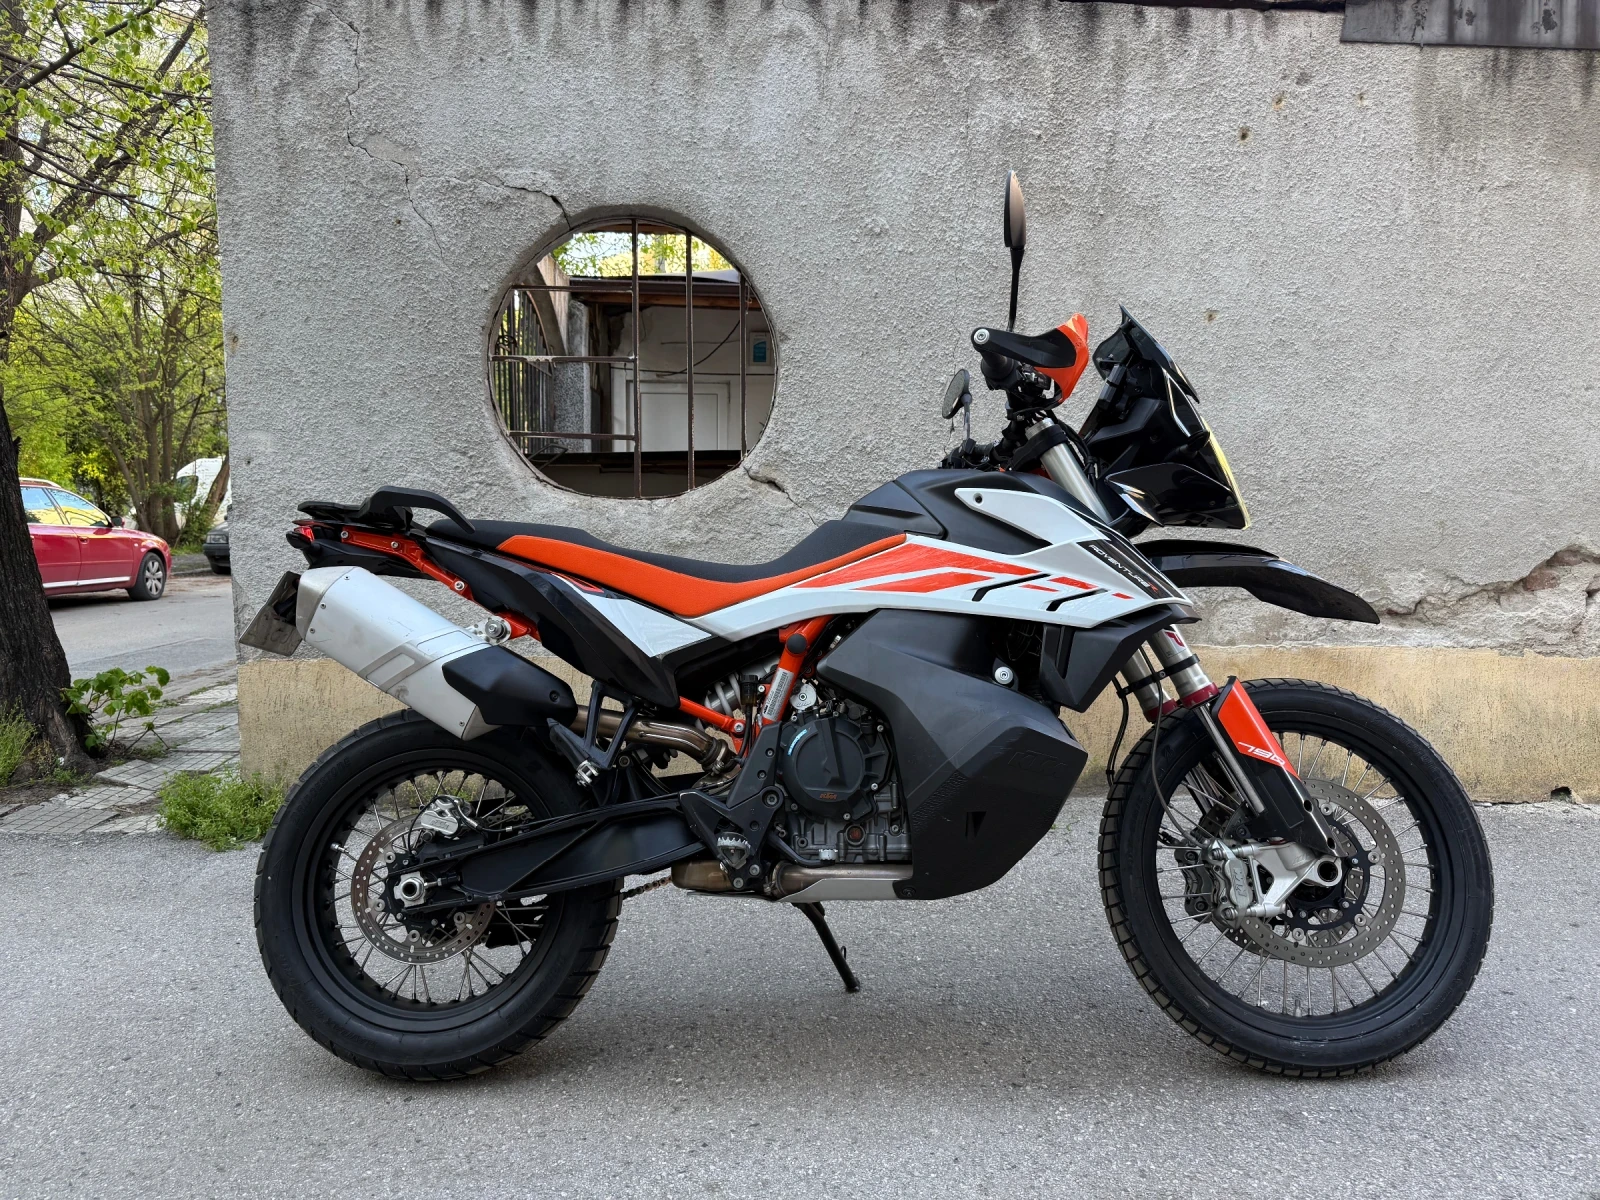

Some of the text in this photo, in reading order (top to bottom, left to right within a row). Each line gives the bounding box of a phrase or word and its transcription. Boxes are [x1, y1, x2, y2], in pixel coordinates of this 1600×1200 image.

[1088, 543, 1151, 588] ADVENTURE
[1237, 741, 1285, 767] 790
[819, 792, 838, 800] KTM
